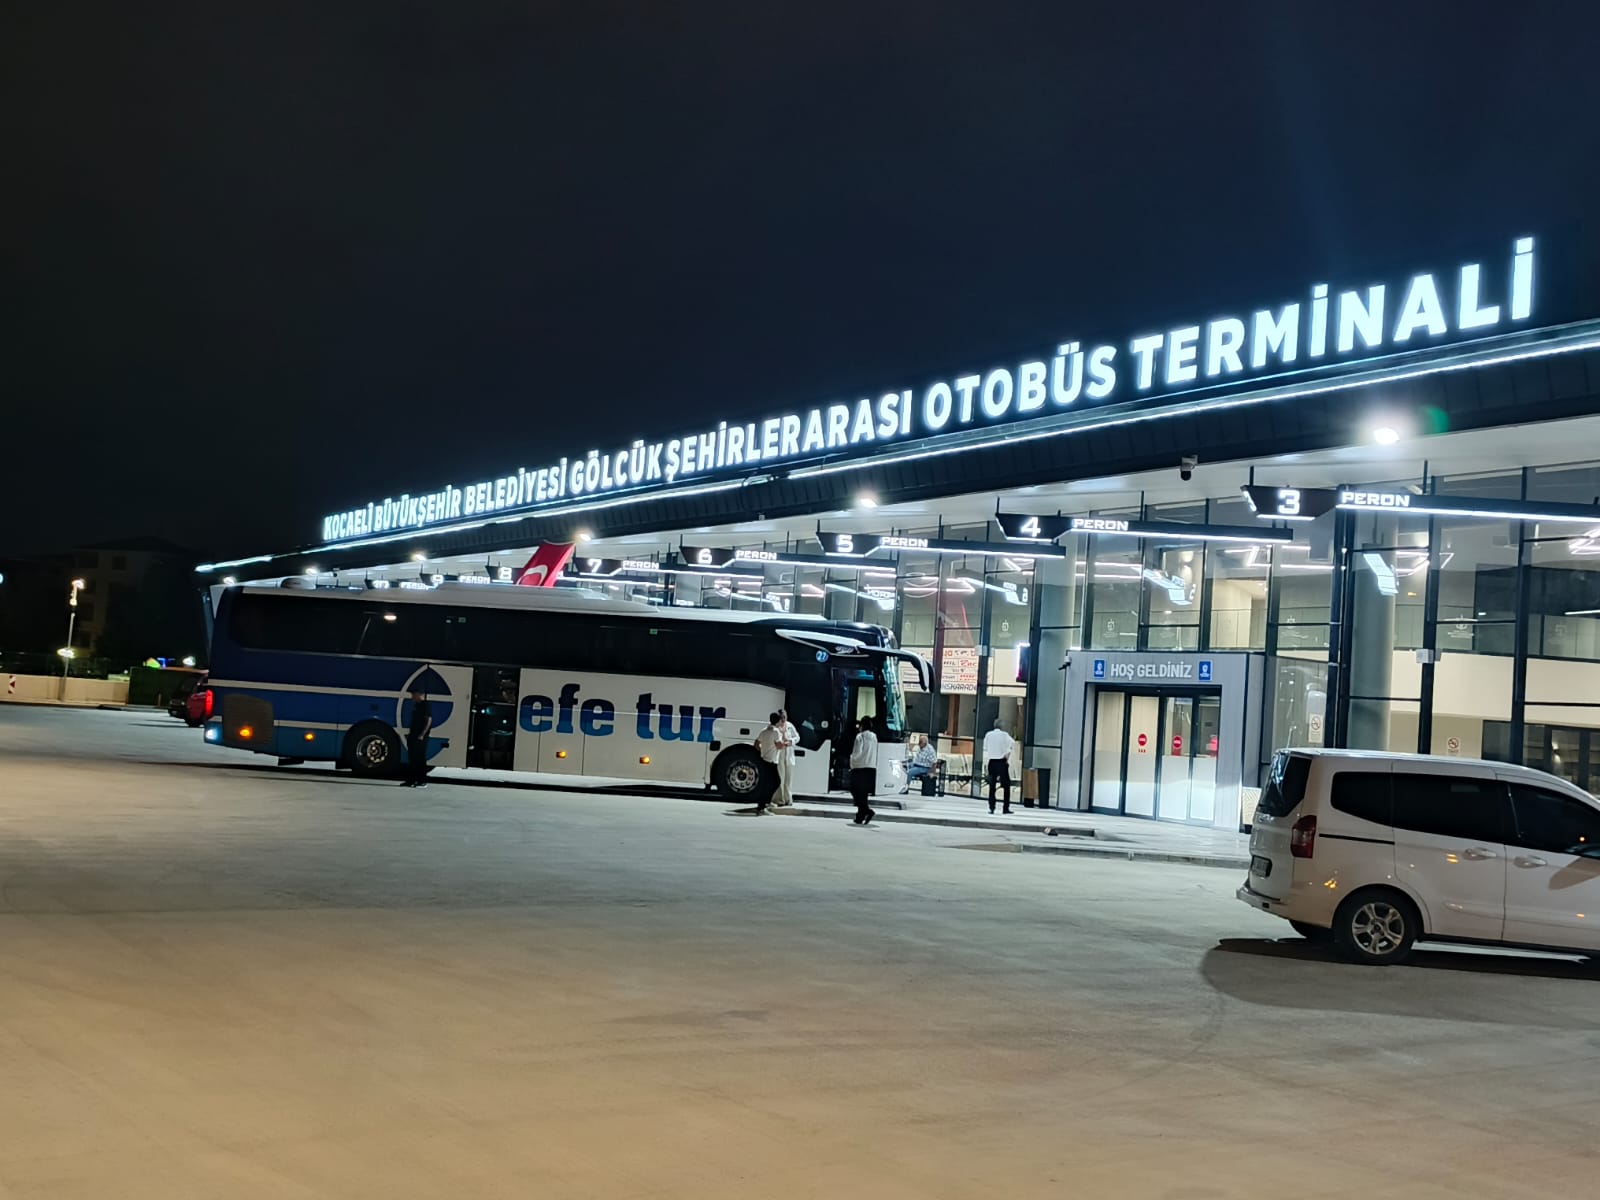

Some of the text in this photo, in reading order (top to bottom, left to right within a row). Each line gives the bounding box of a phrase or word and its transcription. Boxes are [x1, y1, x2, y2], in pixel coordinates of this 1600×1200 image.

[323, 236, 1535, 540] KOCAELİ BÜYÜKŞEHİR BELEDİYESİ GÖLCÜK ŞEHİRLERARASI OTOBÜS TERMİNALİ
[1277, 488, 1411, 515] 3 PERON
[1020, 516, 1130, 538] 4 PERON
[835, 534, 930, 554] 5 PERON
[587, 558, 660, 574] 7 PERON
[698, 548, 778, 565] 6 PERON
[498, 566, 513, 580] 8
[1110, 660, 1193, 681] HOŞ GELDİNİZ
[519, 683, 727, 744] efe tur
